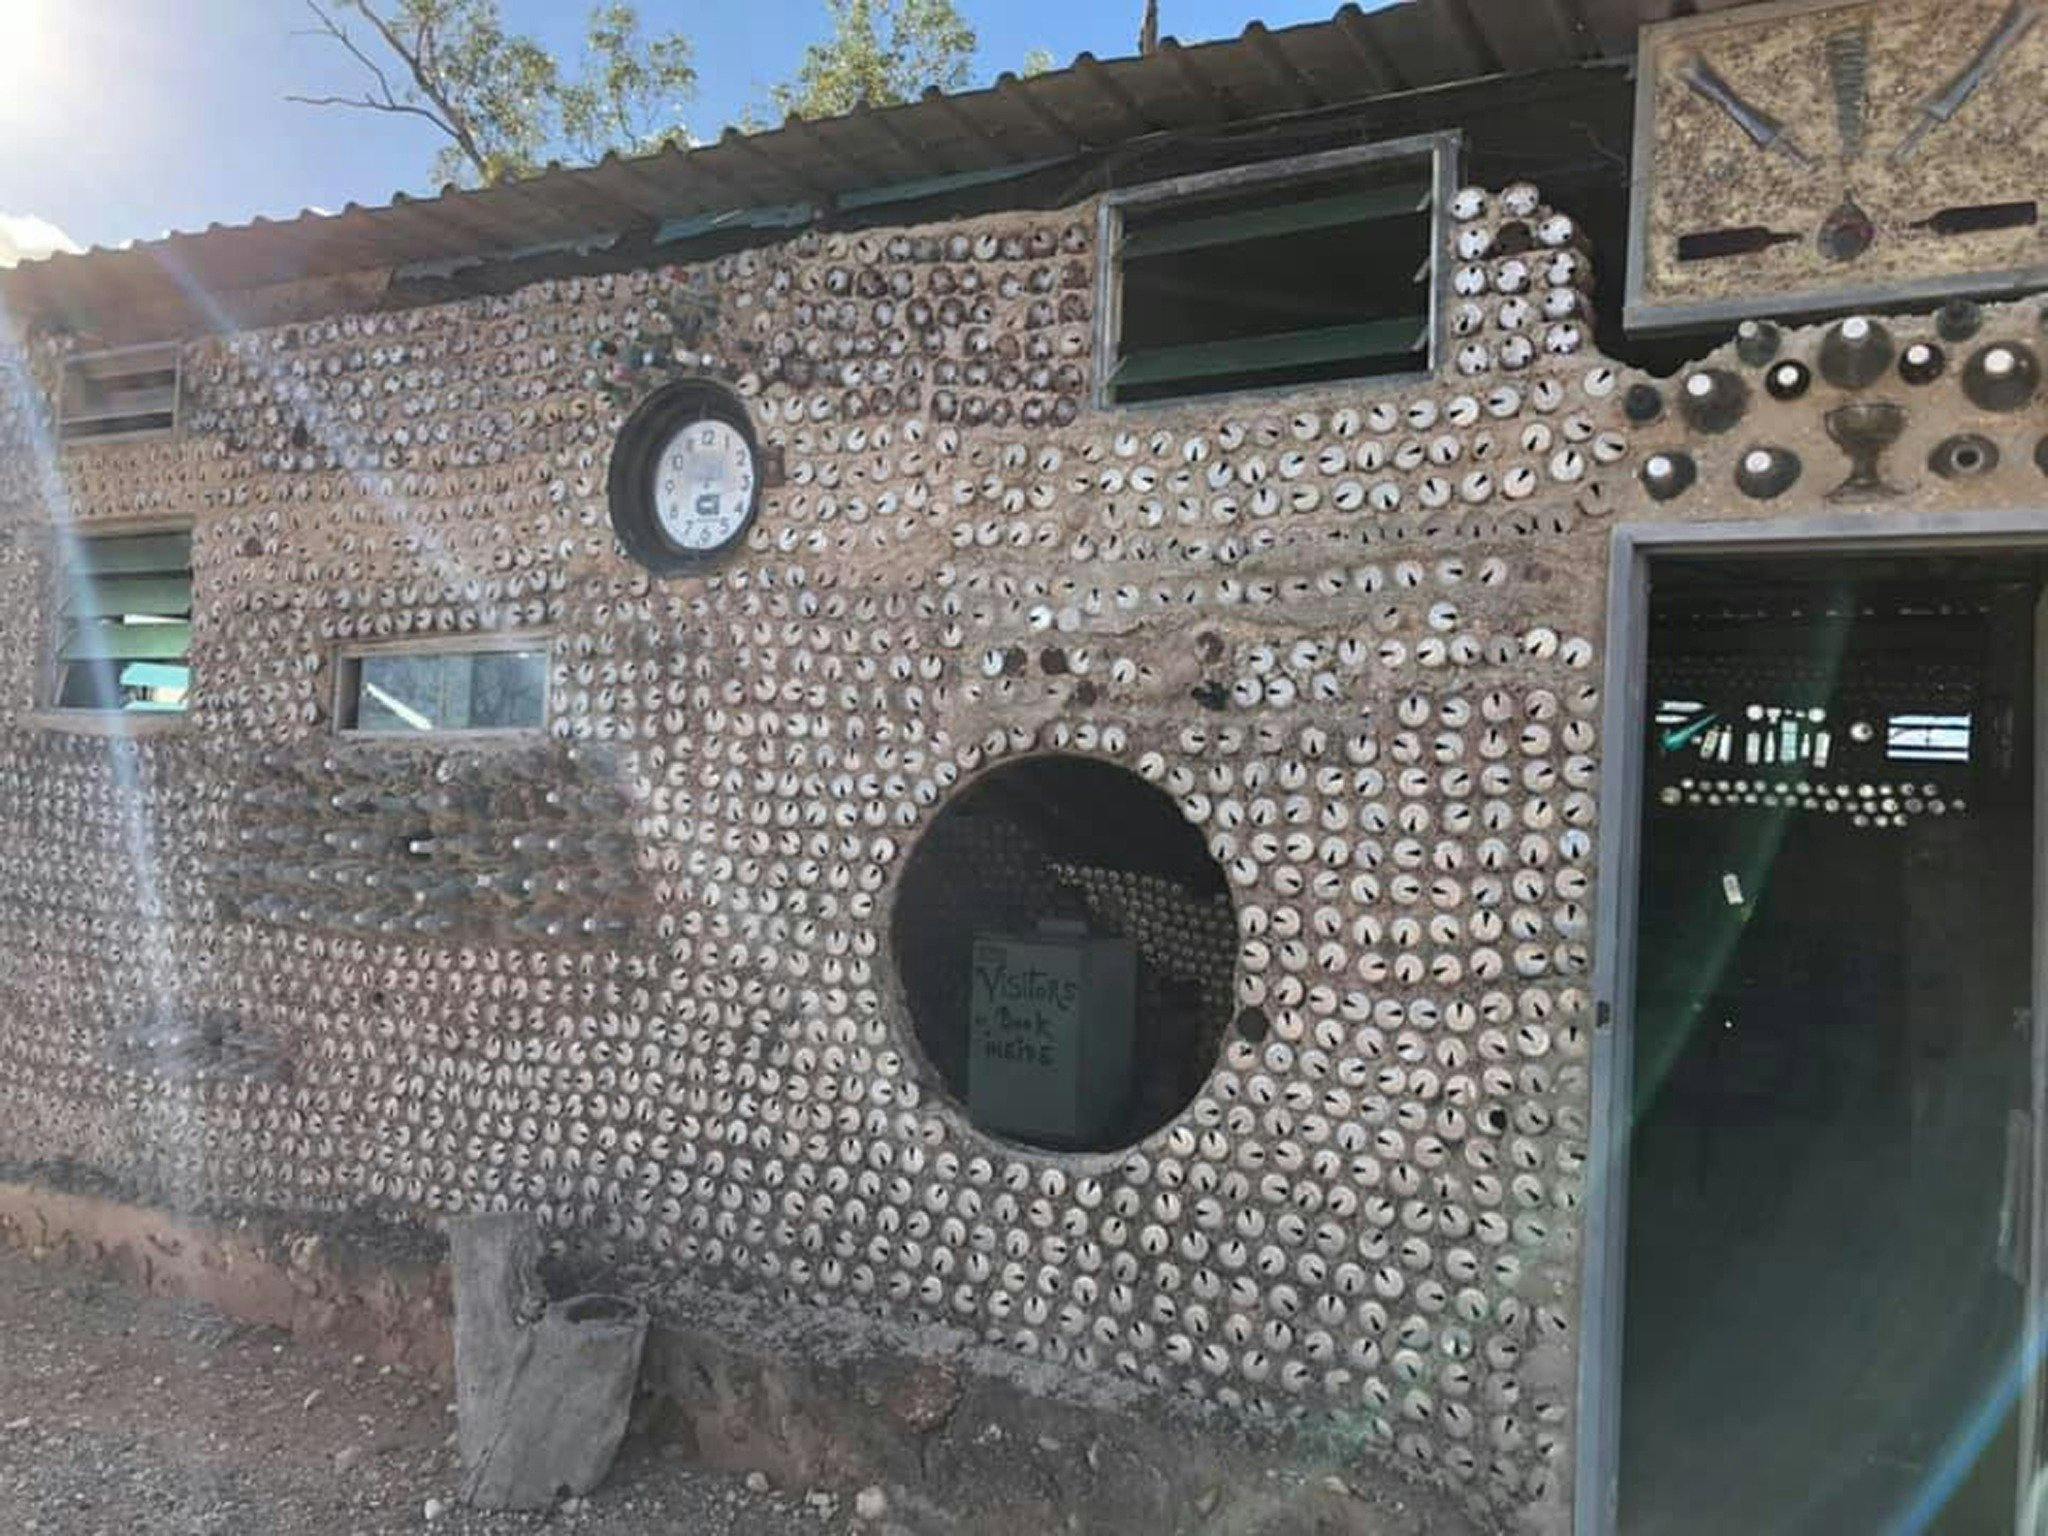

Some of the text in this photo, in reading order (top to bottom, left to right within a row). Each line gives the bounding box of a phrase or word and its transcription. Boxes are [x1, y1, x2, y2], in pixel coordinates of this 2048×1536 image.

[736, 450, 746, 467] 2
[665, 479, 675, 495] 9
[741, 474, 750, 492] 3
[685, 519, 694, 535] 7
[719, 516, 730, 535] 5
[700, 528, 711, 543] 6
